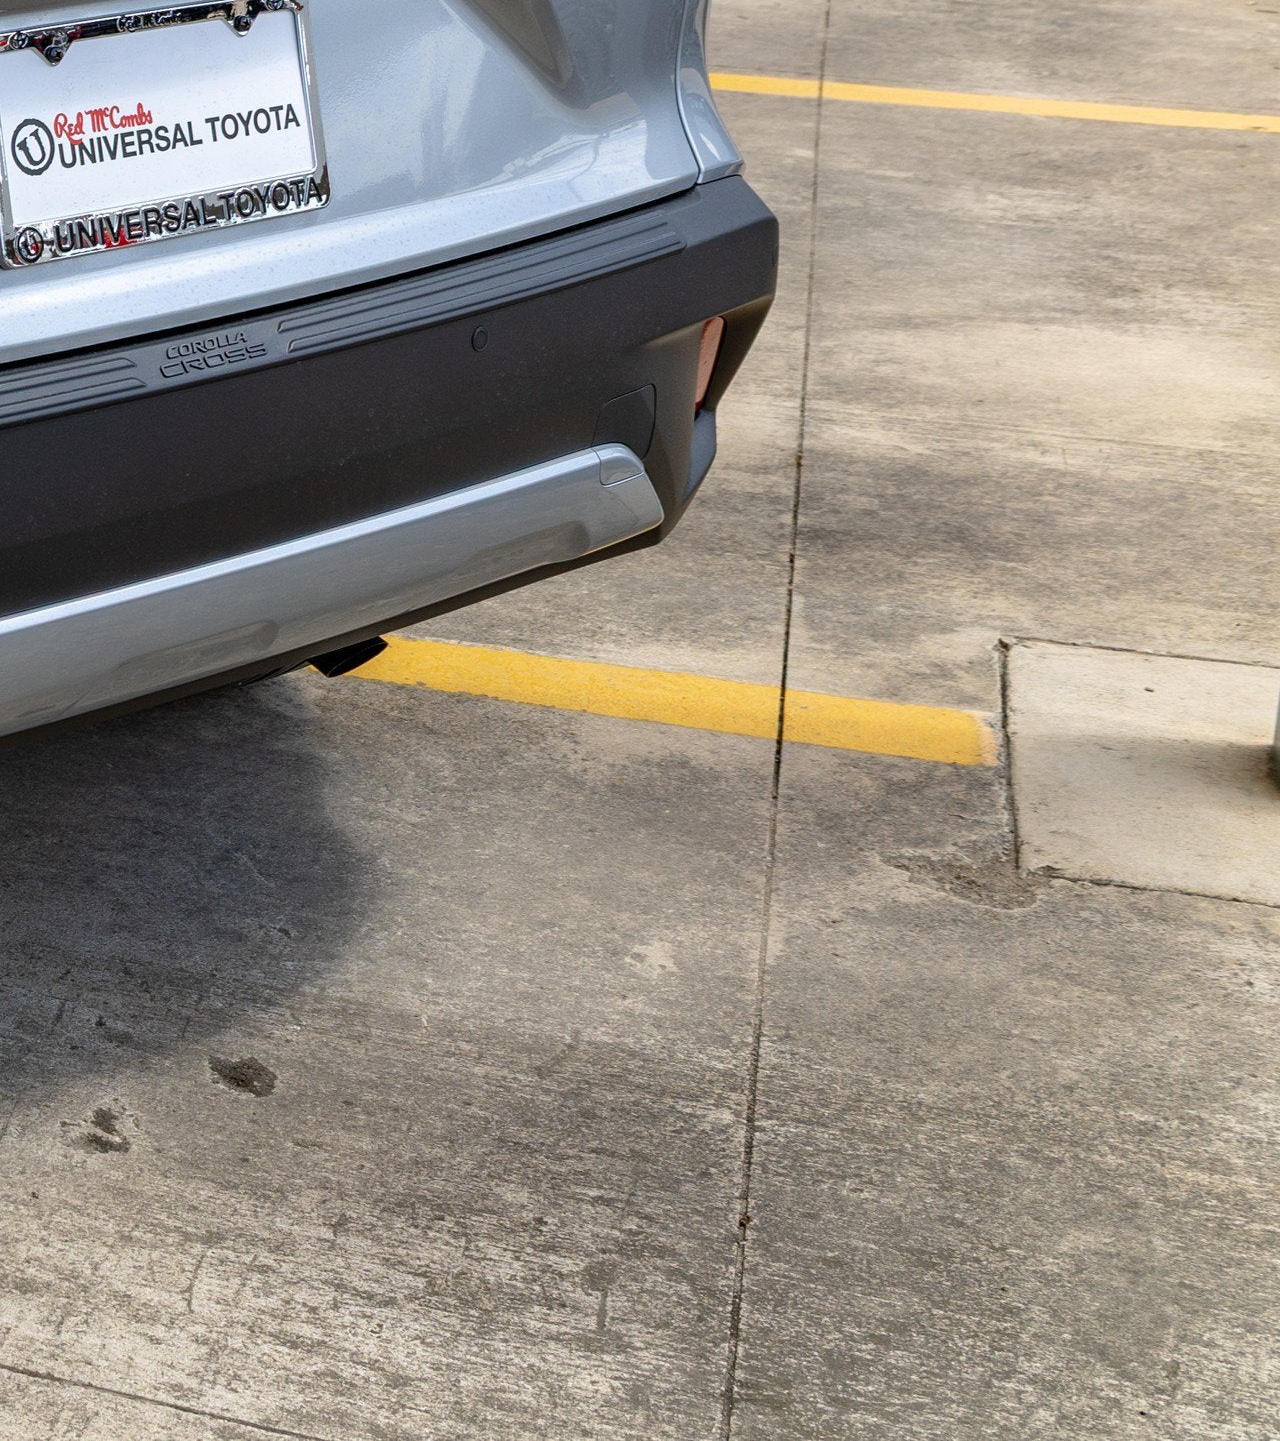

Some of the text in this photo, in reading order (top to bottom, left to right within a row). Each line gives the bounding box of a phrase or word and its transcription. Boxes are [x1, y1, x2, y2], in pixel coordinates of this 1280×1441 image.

[53, 112, 84, 145] Red
[57, 103, 301, 169] UNIVERSAL TOYOTA
[52, 195, 217, 254] UNIVERSAL
[217, 175, 323, 221] TOYOTA
[159, 343, 268, 379] CROSS
[165, 332, 248, 360] COROLLA
